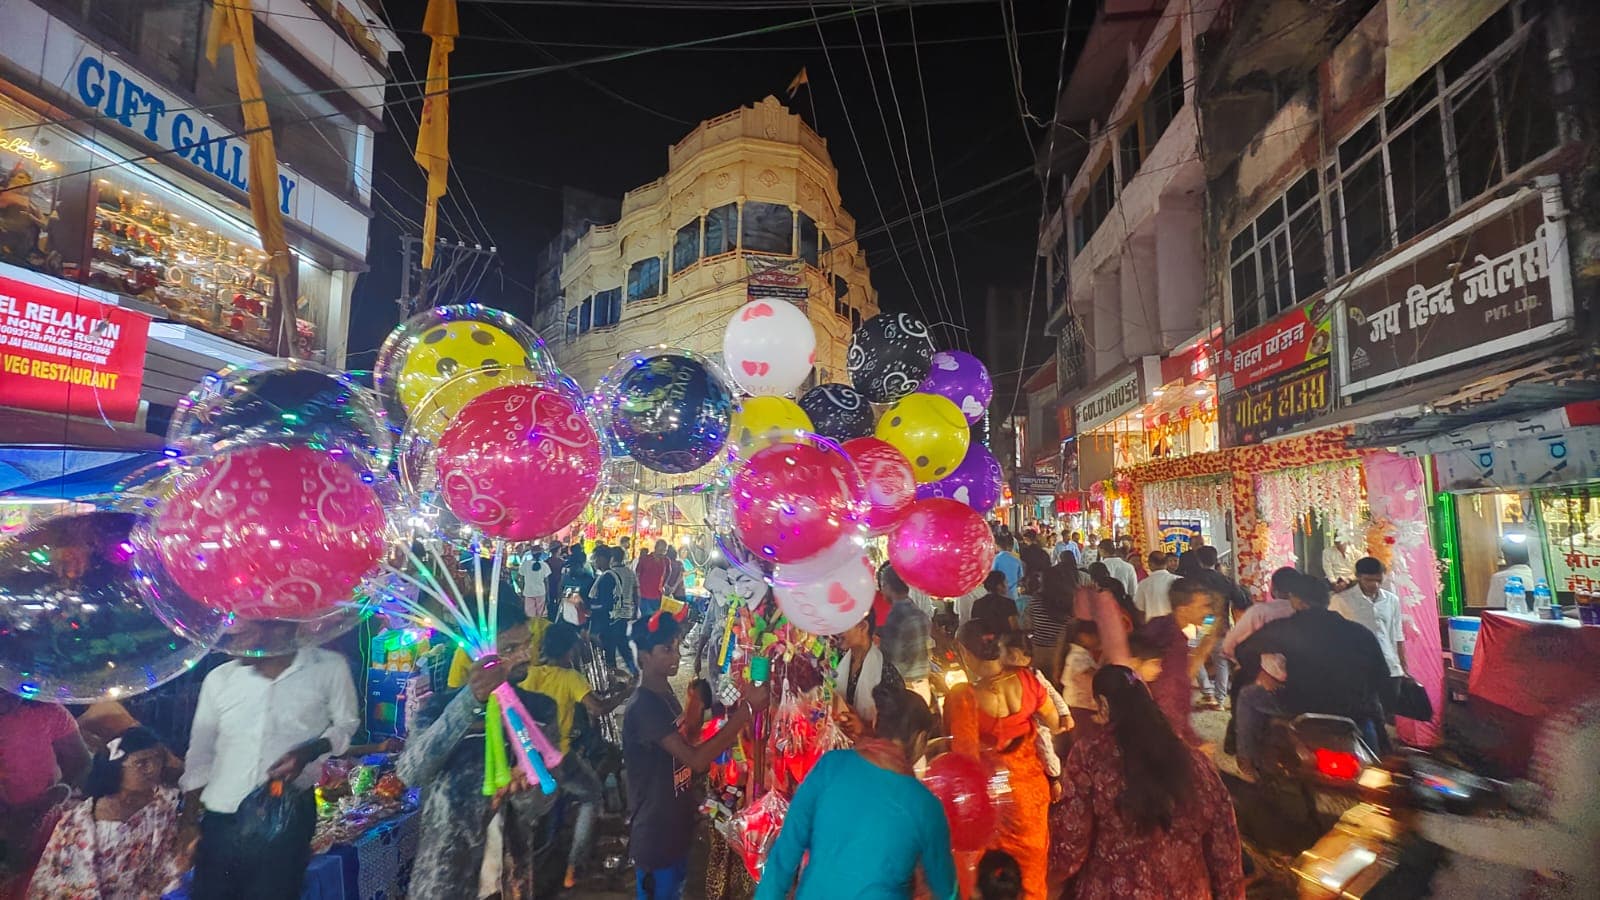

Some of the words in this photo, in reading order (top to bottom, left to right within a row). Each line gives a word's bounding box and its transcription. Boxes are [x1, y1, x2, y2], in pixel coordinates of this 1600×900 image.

[77, 57, 165, 142] GIFT
[172, 113, 296, 215] GALLY
[26, 302, 87, 332] RELAX
[1366, 303, 1401, 343] जय
[1485, 305, 1511, 323] PVT.
[7, 317, 42, 332] NON
[45, 325, 71, 338] A/C
[74, 333, 115, 348] ROOM
[4, 354, 30, 375] VEG
[31, 360, 119, 390] RESTAURANT
[1233, 345, 1262, 372] होटल
[1083, 396, 1104, 422] GOLD
[1236, 389, 1273, 427] गोल्ड
[1277, 371, 1327, 416] हाउस
